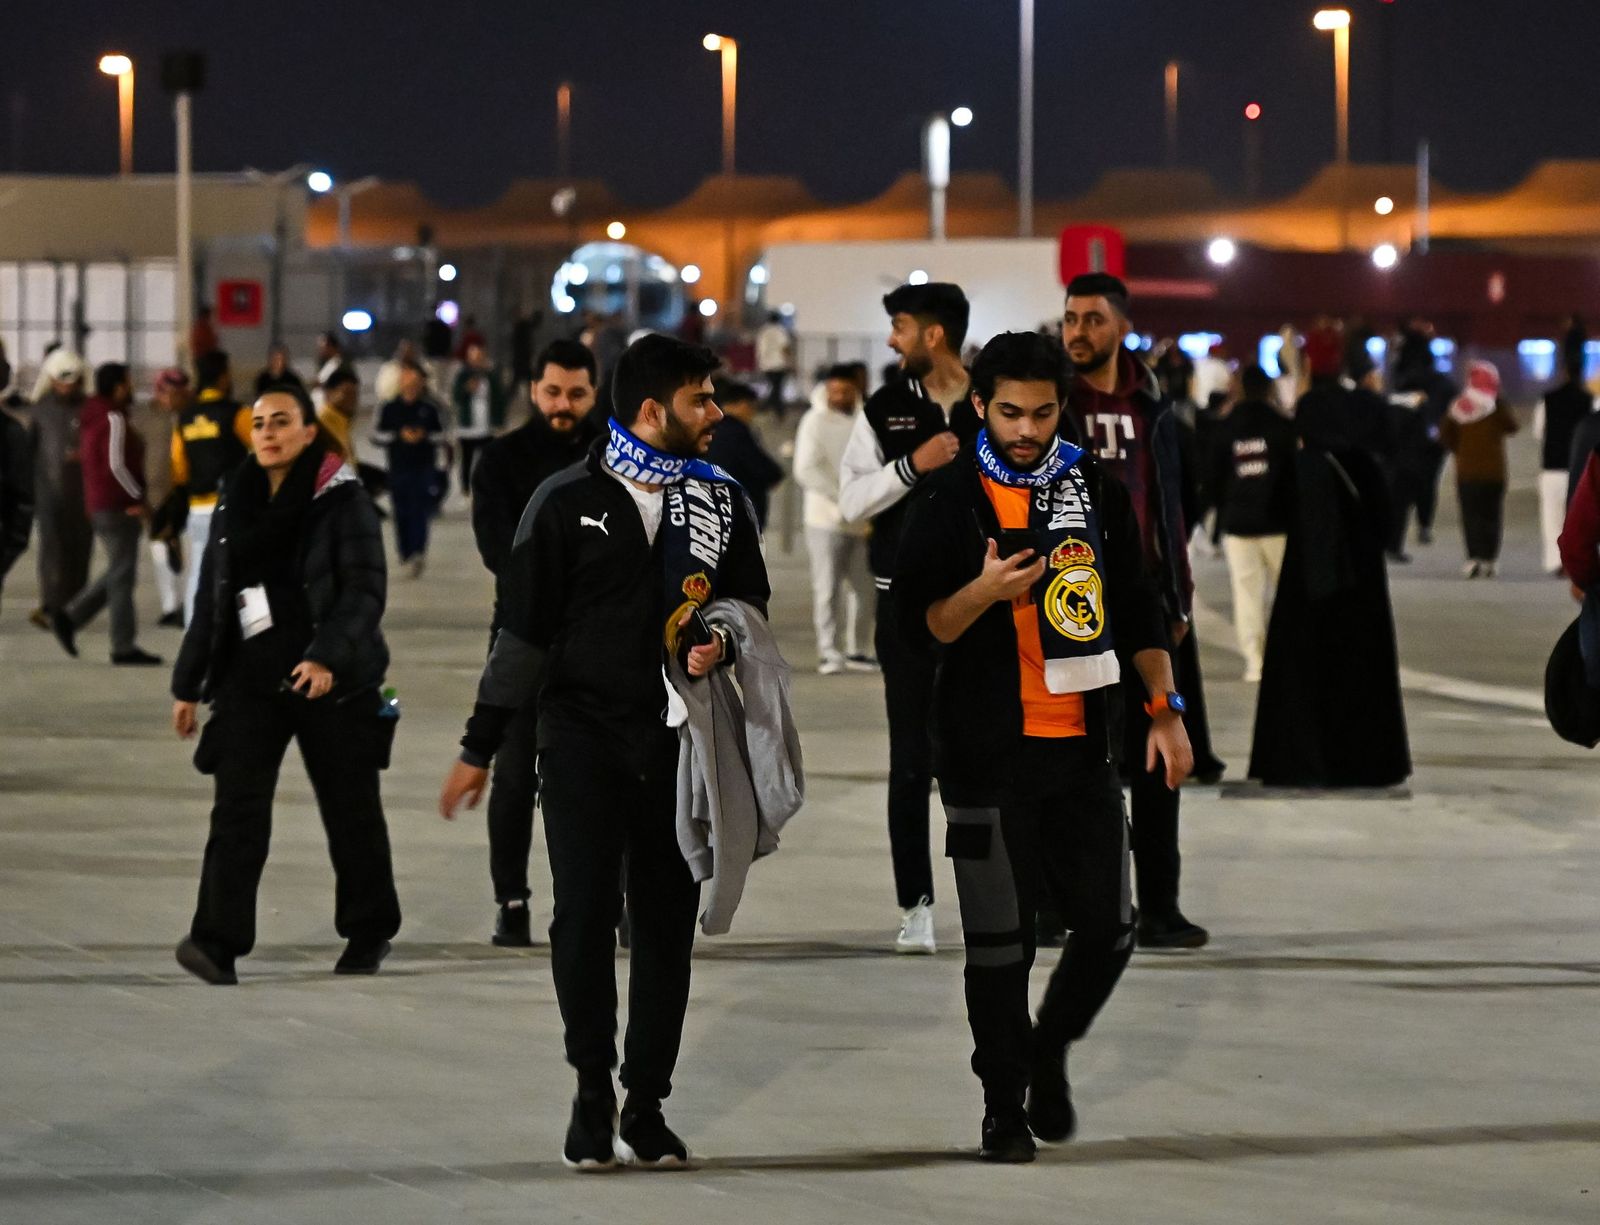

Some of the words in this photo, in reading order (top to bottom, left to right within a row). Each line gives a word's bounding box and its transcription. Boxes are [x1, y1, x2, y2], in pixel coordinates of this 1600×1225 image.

[607, 423, 646, 464] ATAR
[650, 456, 687, 473] 202
[979, 444, 1012, 484] LUSAIL
[1069, 464, 1092, 512] 18.12.
[688, 502, 721, 570] REAL
